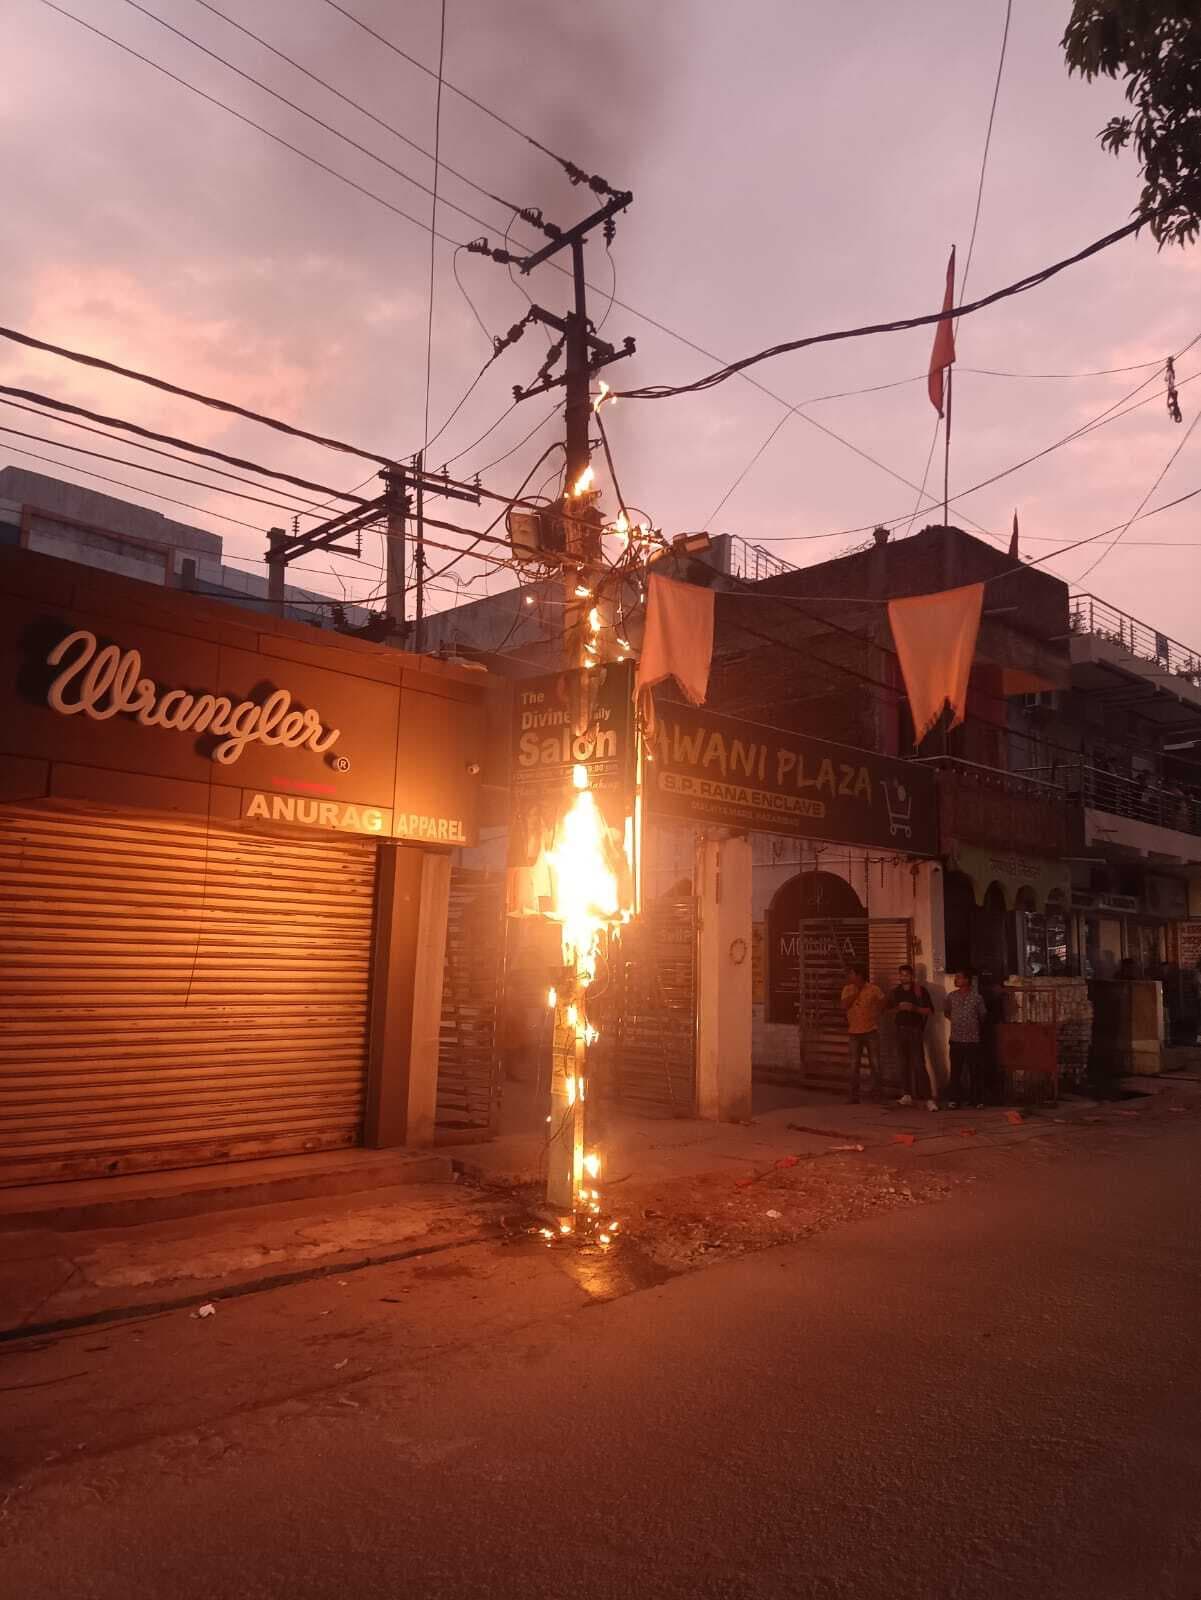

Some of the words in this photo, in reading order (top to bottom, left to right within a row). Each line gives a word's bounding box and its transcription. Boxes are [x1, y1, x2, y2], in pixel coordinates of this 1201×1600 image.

[48, 630, 340, 765] Wrangler
[521, 692, 545, 705] The
[518, 728, 617, 767] Salon
[701, 782, 749, 804] RANA
[752, 792, 823, 816] ENCLAVE
[777, 747, 873, 808] PLAZA
[246, 794, 382, 831] ANURAG
[397, 813, 466, 842] APPAREL
